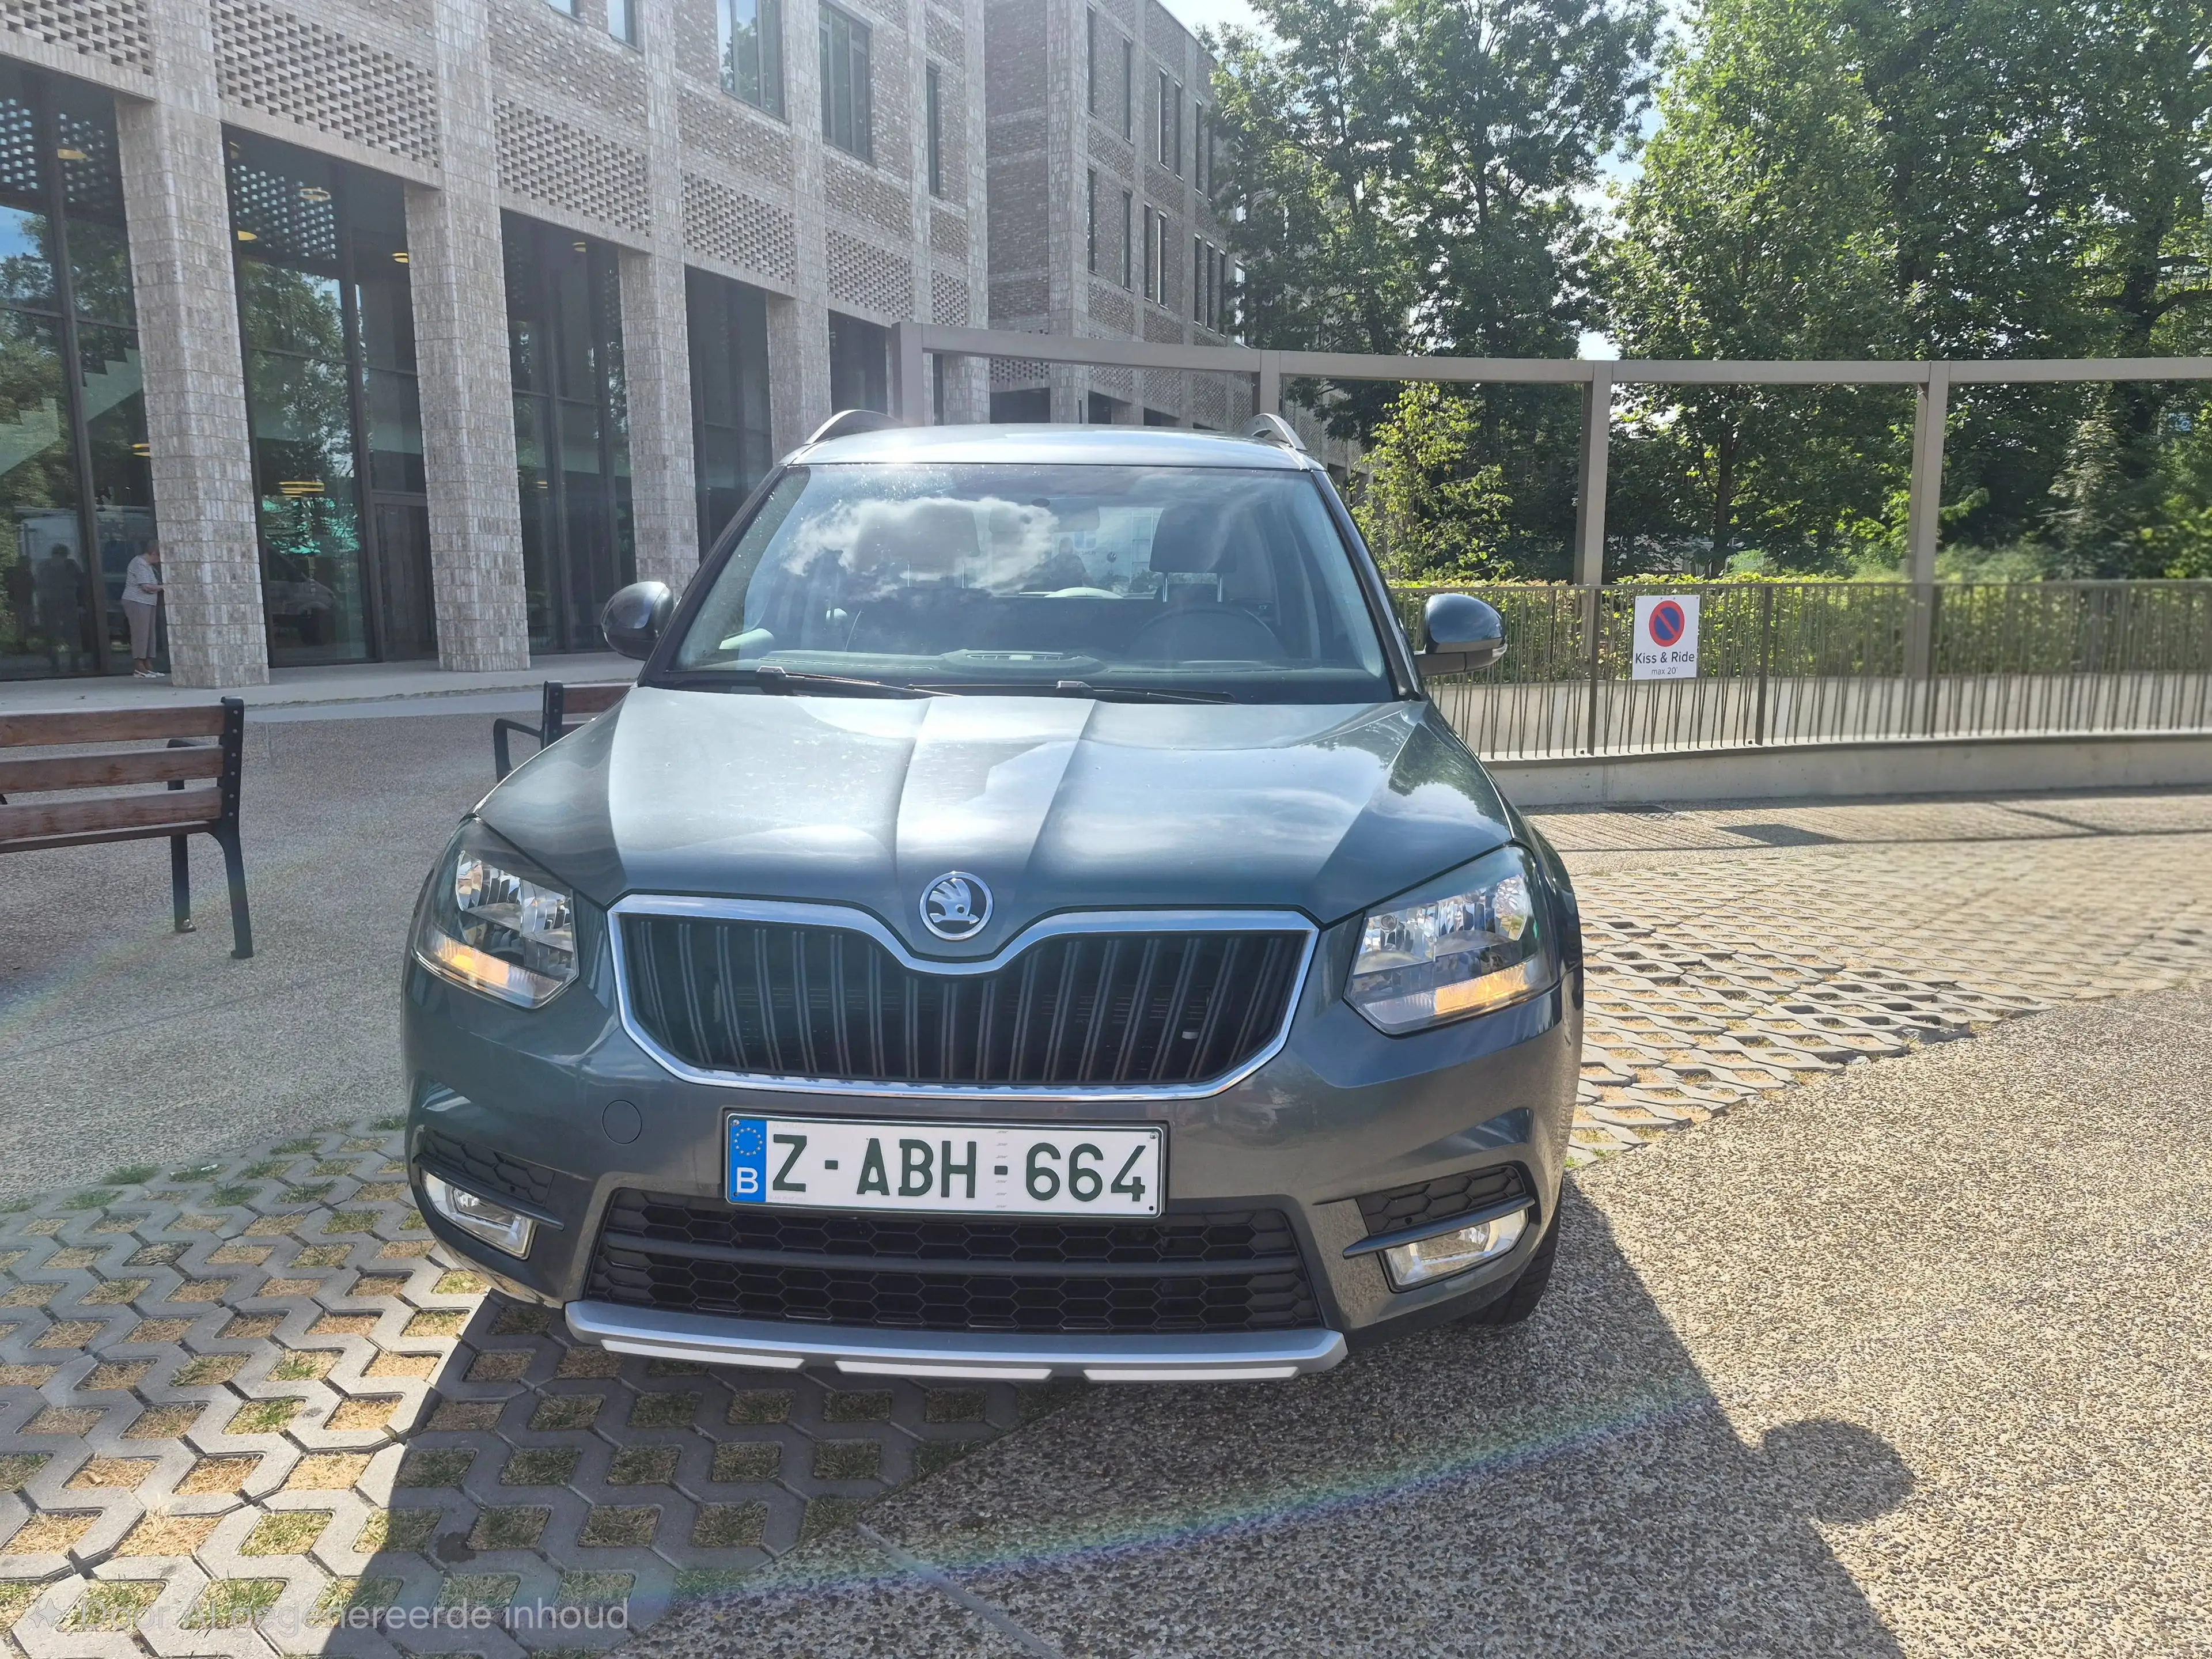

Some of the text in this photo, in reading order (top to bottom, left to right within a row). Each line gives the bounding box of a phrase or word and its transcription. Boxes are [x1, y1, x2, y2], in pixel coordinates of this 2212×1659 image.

[1635, 651, 1695, 664] Kiss & Ride
[736, 1167, 759, 1194] B
[772, 1134, 1146, 1202] Z-ABH-664
